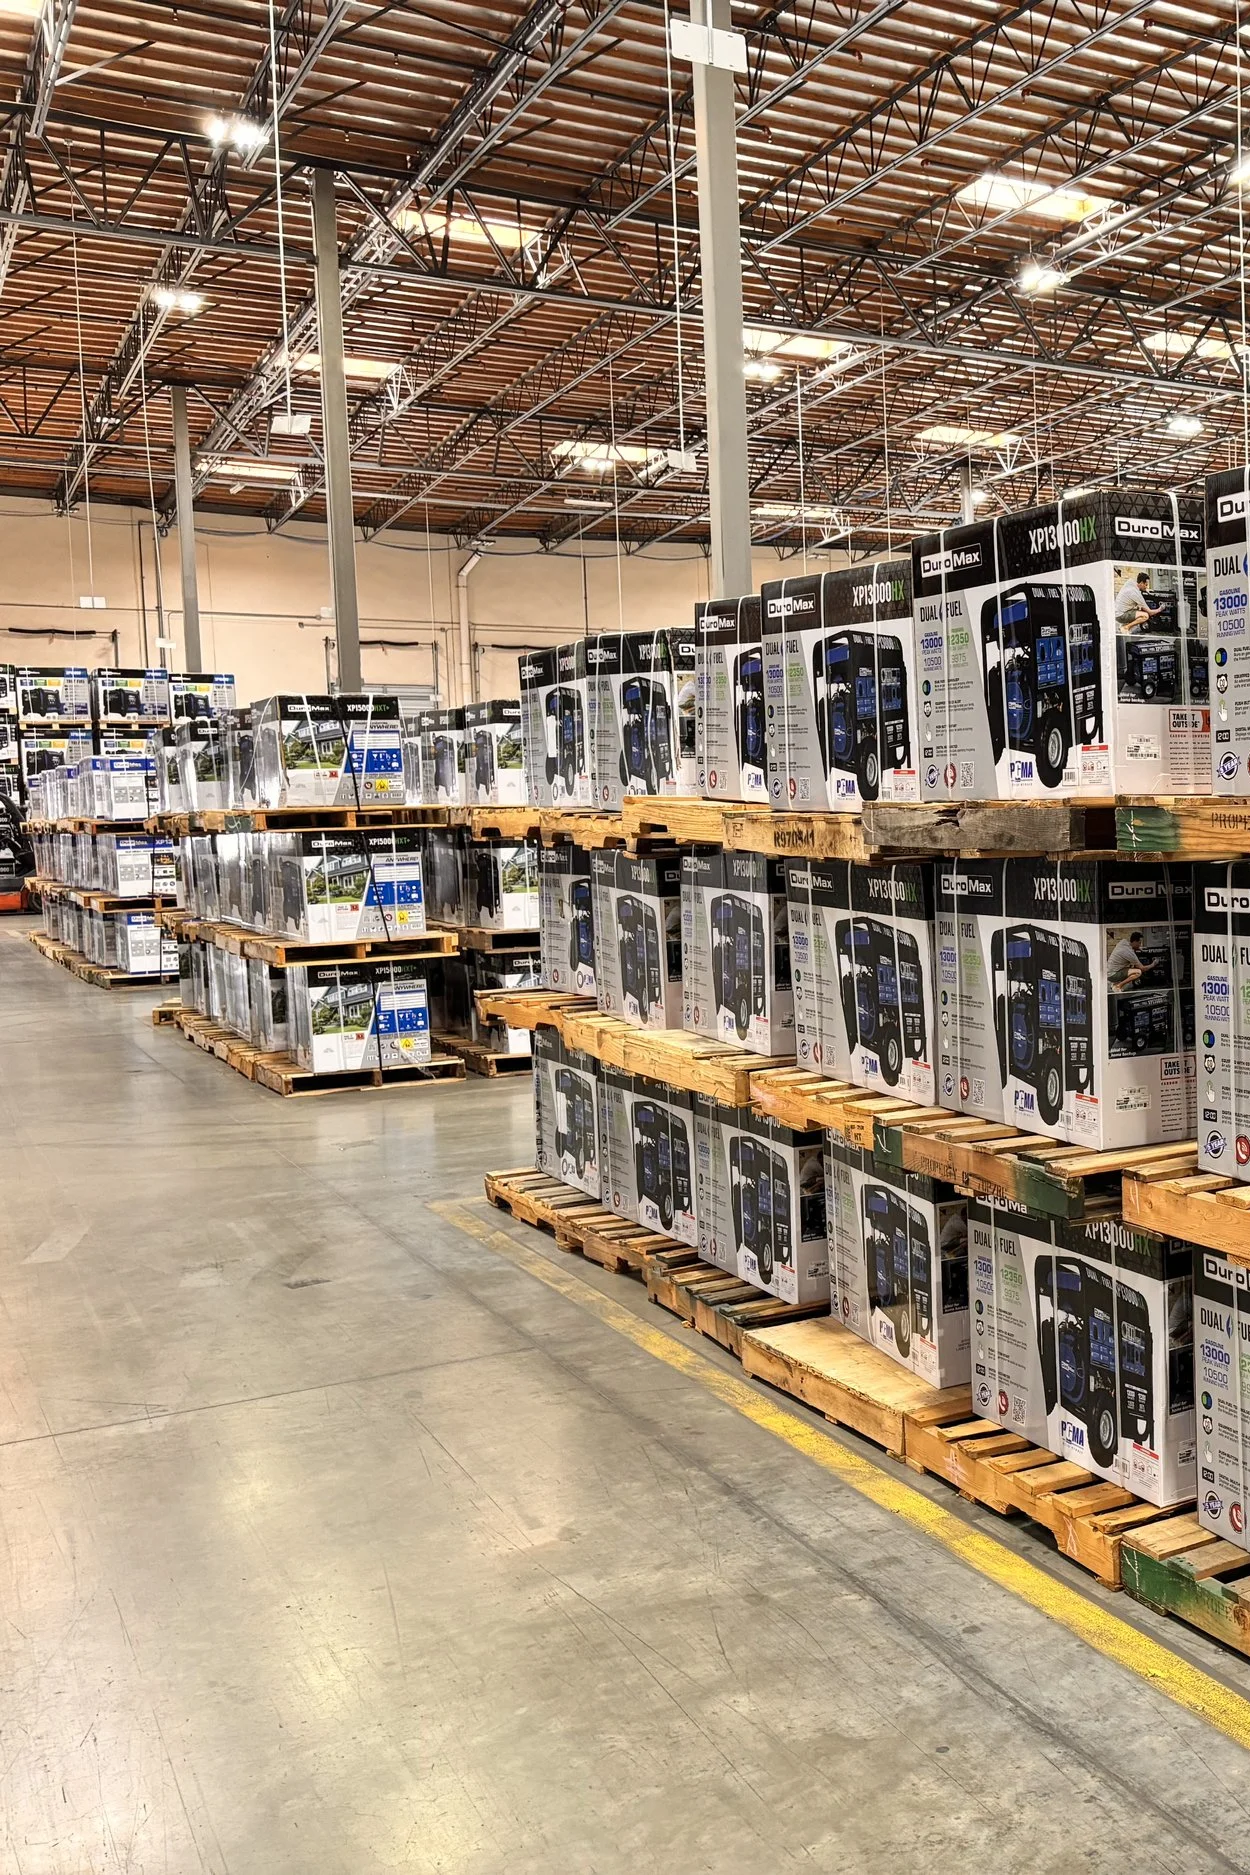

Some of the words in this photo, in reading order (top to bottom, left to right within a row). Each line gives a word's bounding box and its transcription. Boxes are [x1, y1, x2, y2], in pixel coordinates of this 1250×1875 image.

[1028, 515, 1097, 555] XP13000HX
[923, 550, 980, 573] DuroMax
[1214, 557, 1242, 578] DUAL
[1219, 588, 1241, 596] GASOLINE
[768, 598, 814, 614] DuroMax
[920, 604, 938, 622] DUAL
[945, 600, 963, 618] FUEL
[1213, 593, 1248, 611] 13000
[1215, 608, 1230, 618] PEAK
[1230, 608, 1246, 617] WATTS
[1216, 617, 1246, 632] 10500
[765, 641, 780, 656] DUAL
[920, 636, 943, 650] 13000
[941, 876, 991, 894] DuroMax
[1201, 944, 1227, 965] DUAL
[973, 1230, 993, 1248] DUAL
[999, 1238, 1017, 1257] FUEL
[1200, 1307, 1225, 1333] DUAL
[1199, 1344, 1231, 1368] 13000
